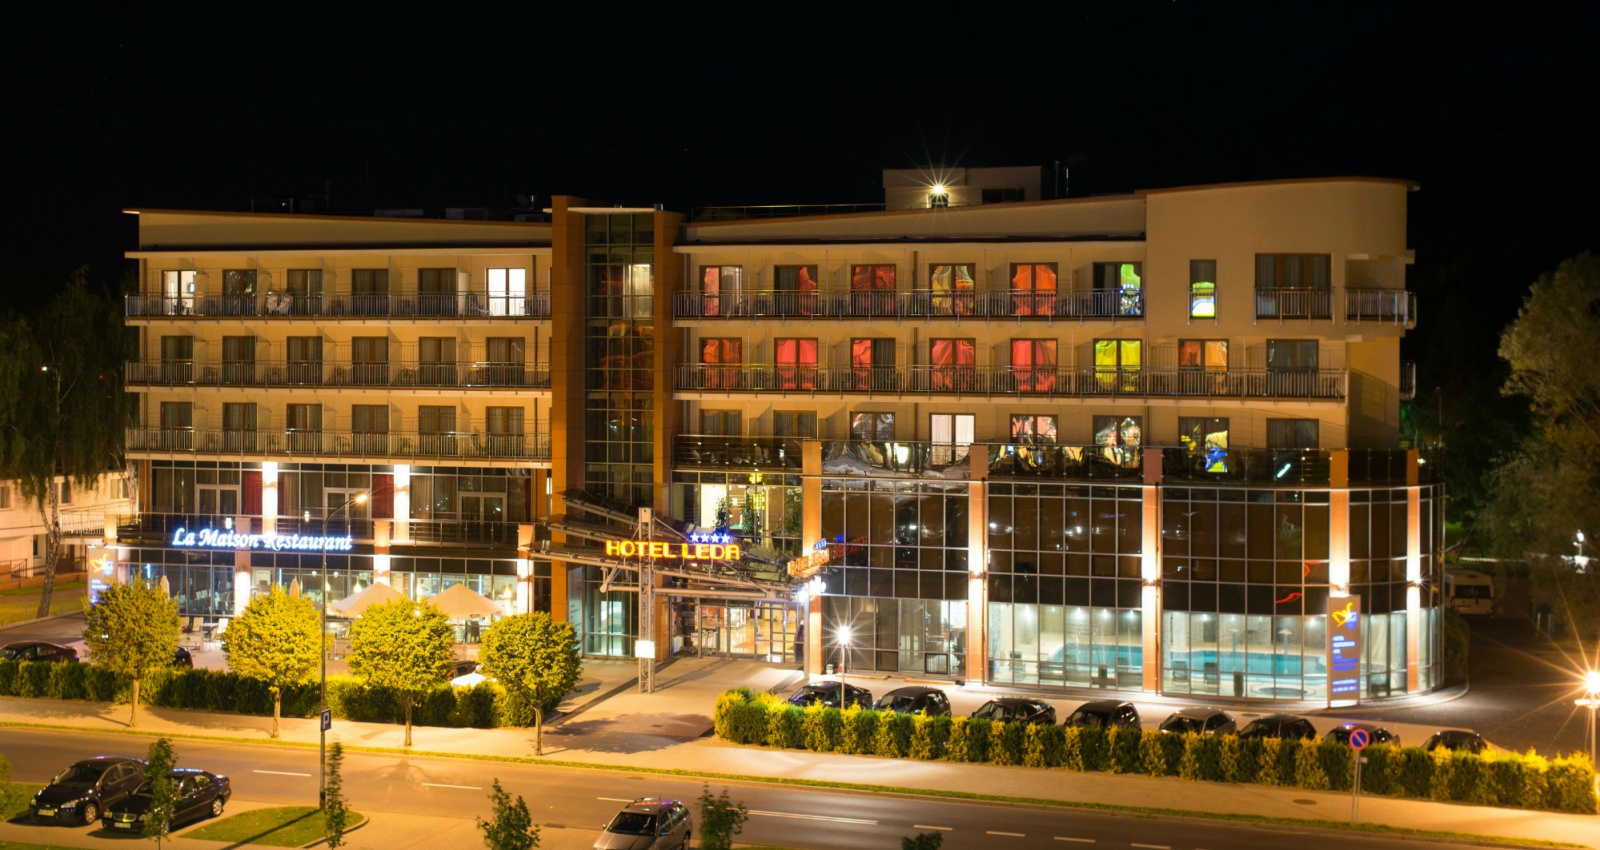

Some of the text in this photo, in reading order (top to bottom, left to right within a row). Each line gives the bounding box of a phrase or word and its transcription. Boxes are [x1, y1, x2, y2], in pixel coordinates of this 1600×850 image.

[172, 527, 353, 552] La Maison Restaurant
[605, 540, 740, 561] HOTEL LEDA
[323, 712, 329, 730] P
